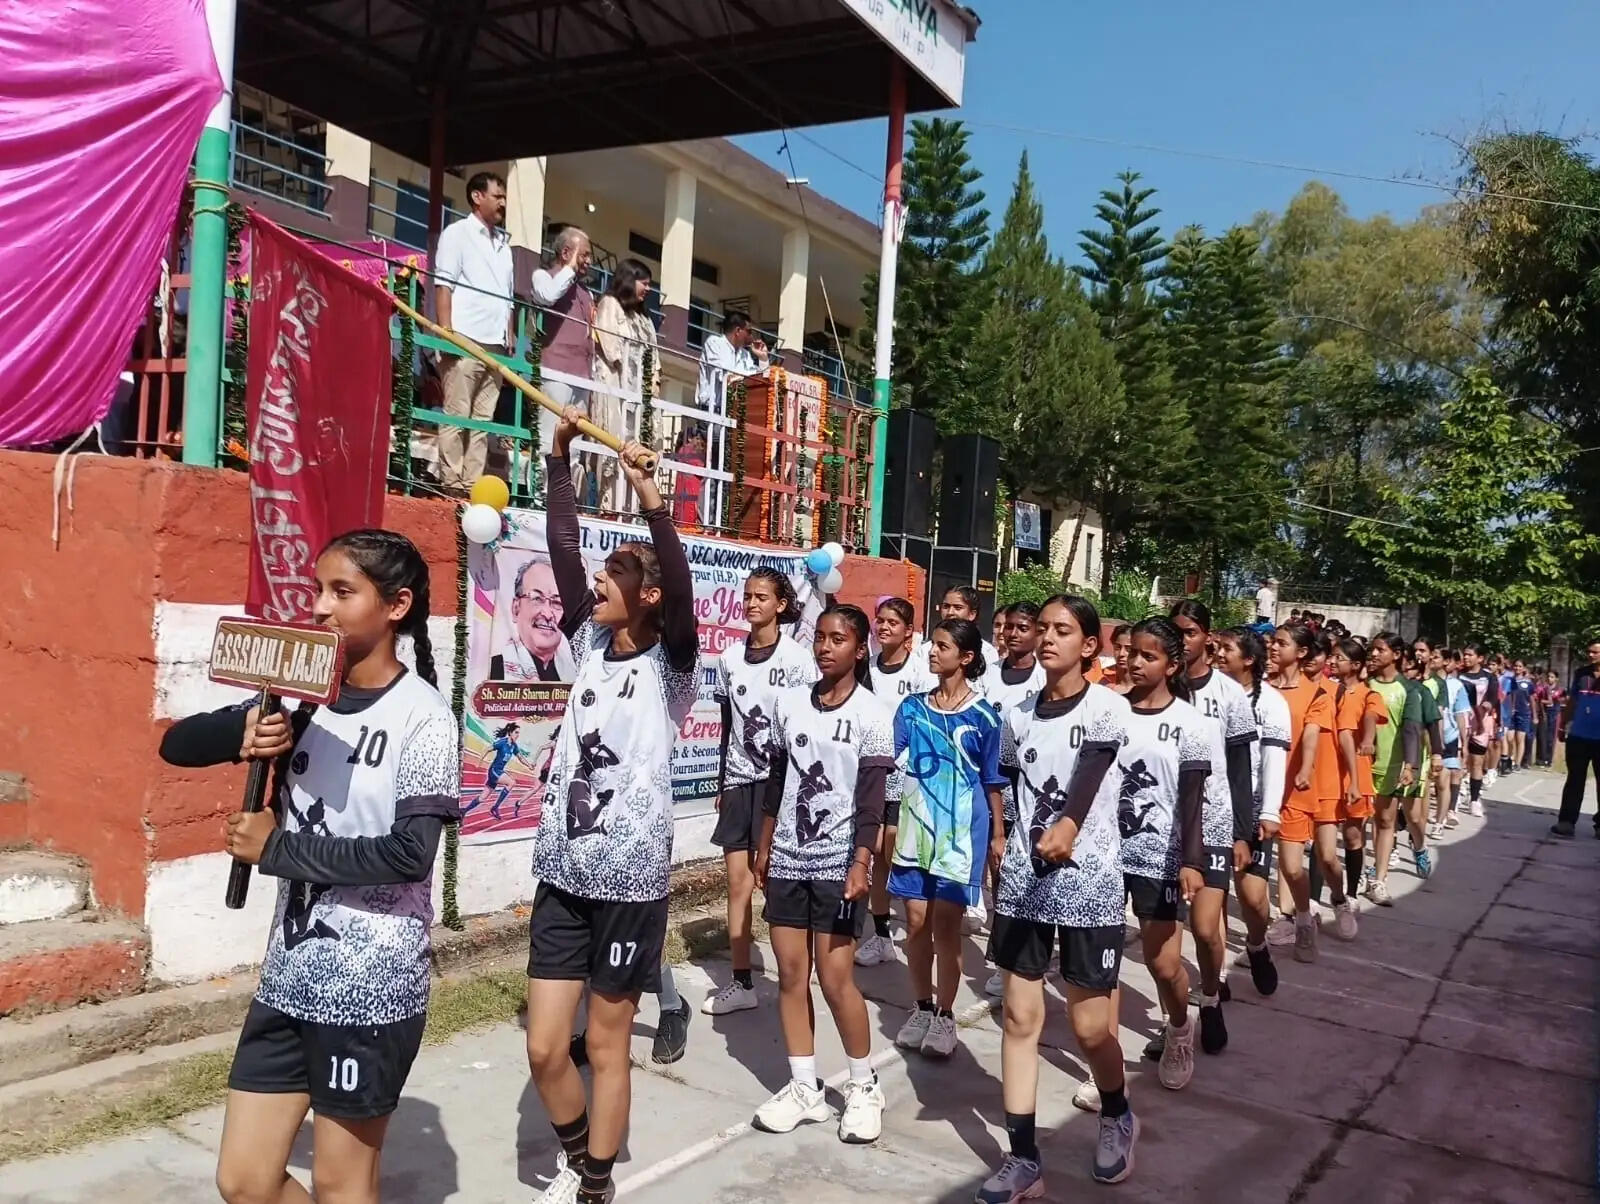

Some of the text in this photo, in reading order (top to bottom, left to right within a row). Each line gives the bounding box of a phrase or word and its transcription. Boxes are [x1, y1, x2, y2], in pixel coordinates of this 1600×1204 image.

[769, 668, 785, 687] 02
[481, 688, 495, 700] Sh.
[497, 687, 520, 700] Sunil
[522, 688, 550, 701] Sharma
[484, 703, 512, 713] Political
[512, 703, 538, 713] Advisor
[1203, 697, 1219, 719] 12
[832, 718, 852, 743] 11
[1158, 723, 1182, 746] 04
[348, 725, 388, 768] 10
[681, 746, 689, 758] &
[692, 745, 721, 758] Second
[668, 761, 718, 776] Tournament
[671, 782, 697, 797] round,
[1209, 854, 1226, 872] 12
[1252, 850, 1266, 866] 01
[609, 941, 637, 967] 07
[1102, 948, 1115, 968] 08
[328, 1056, 359, 1092] 10
